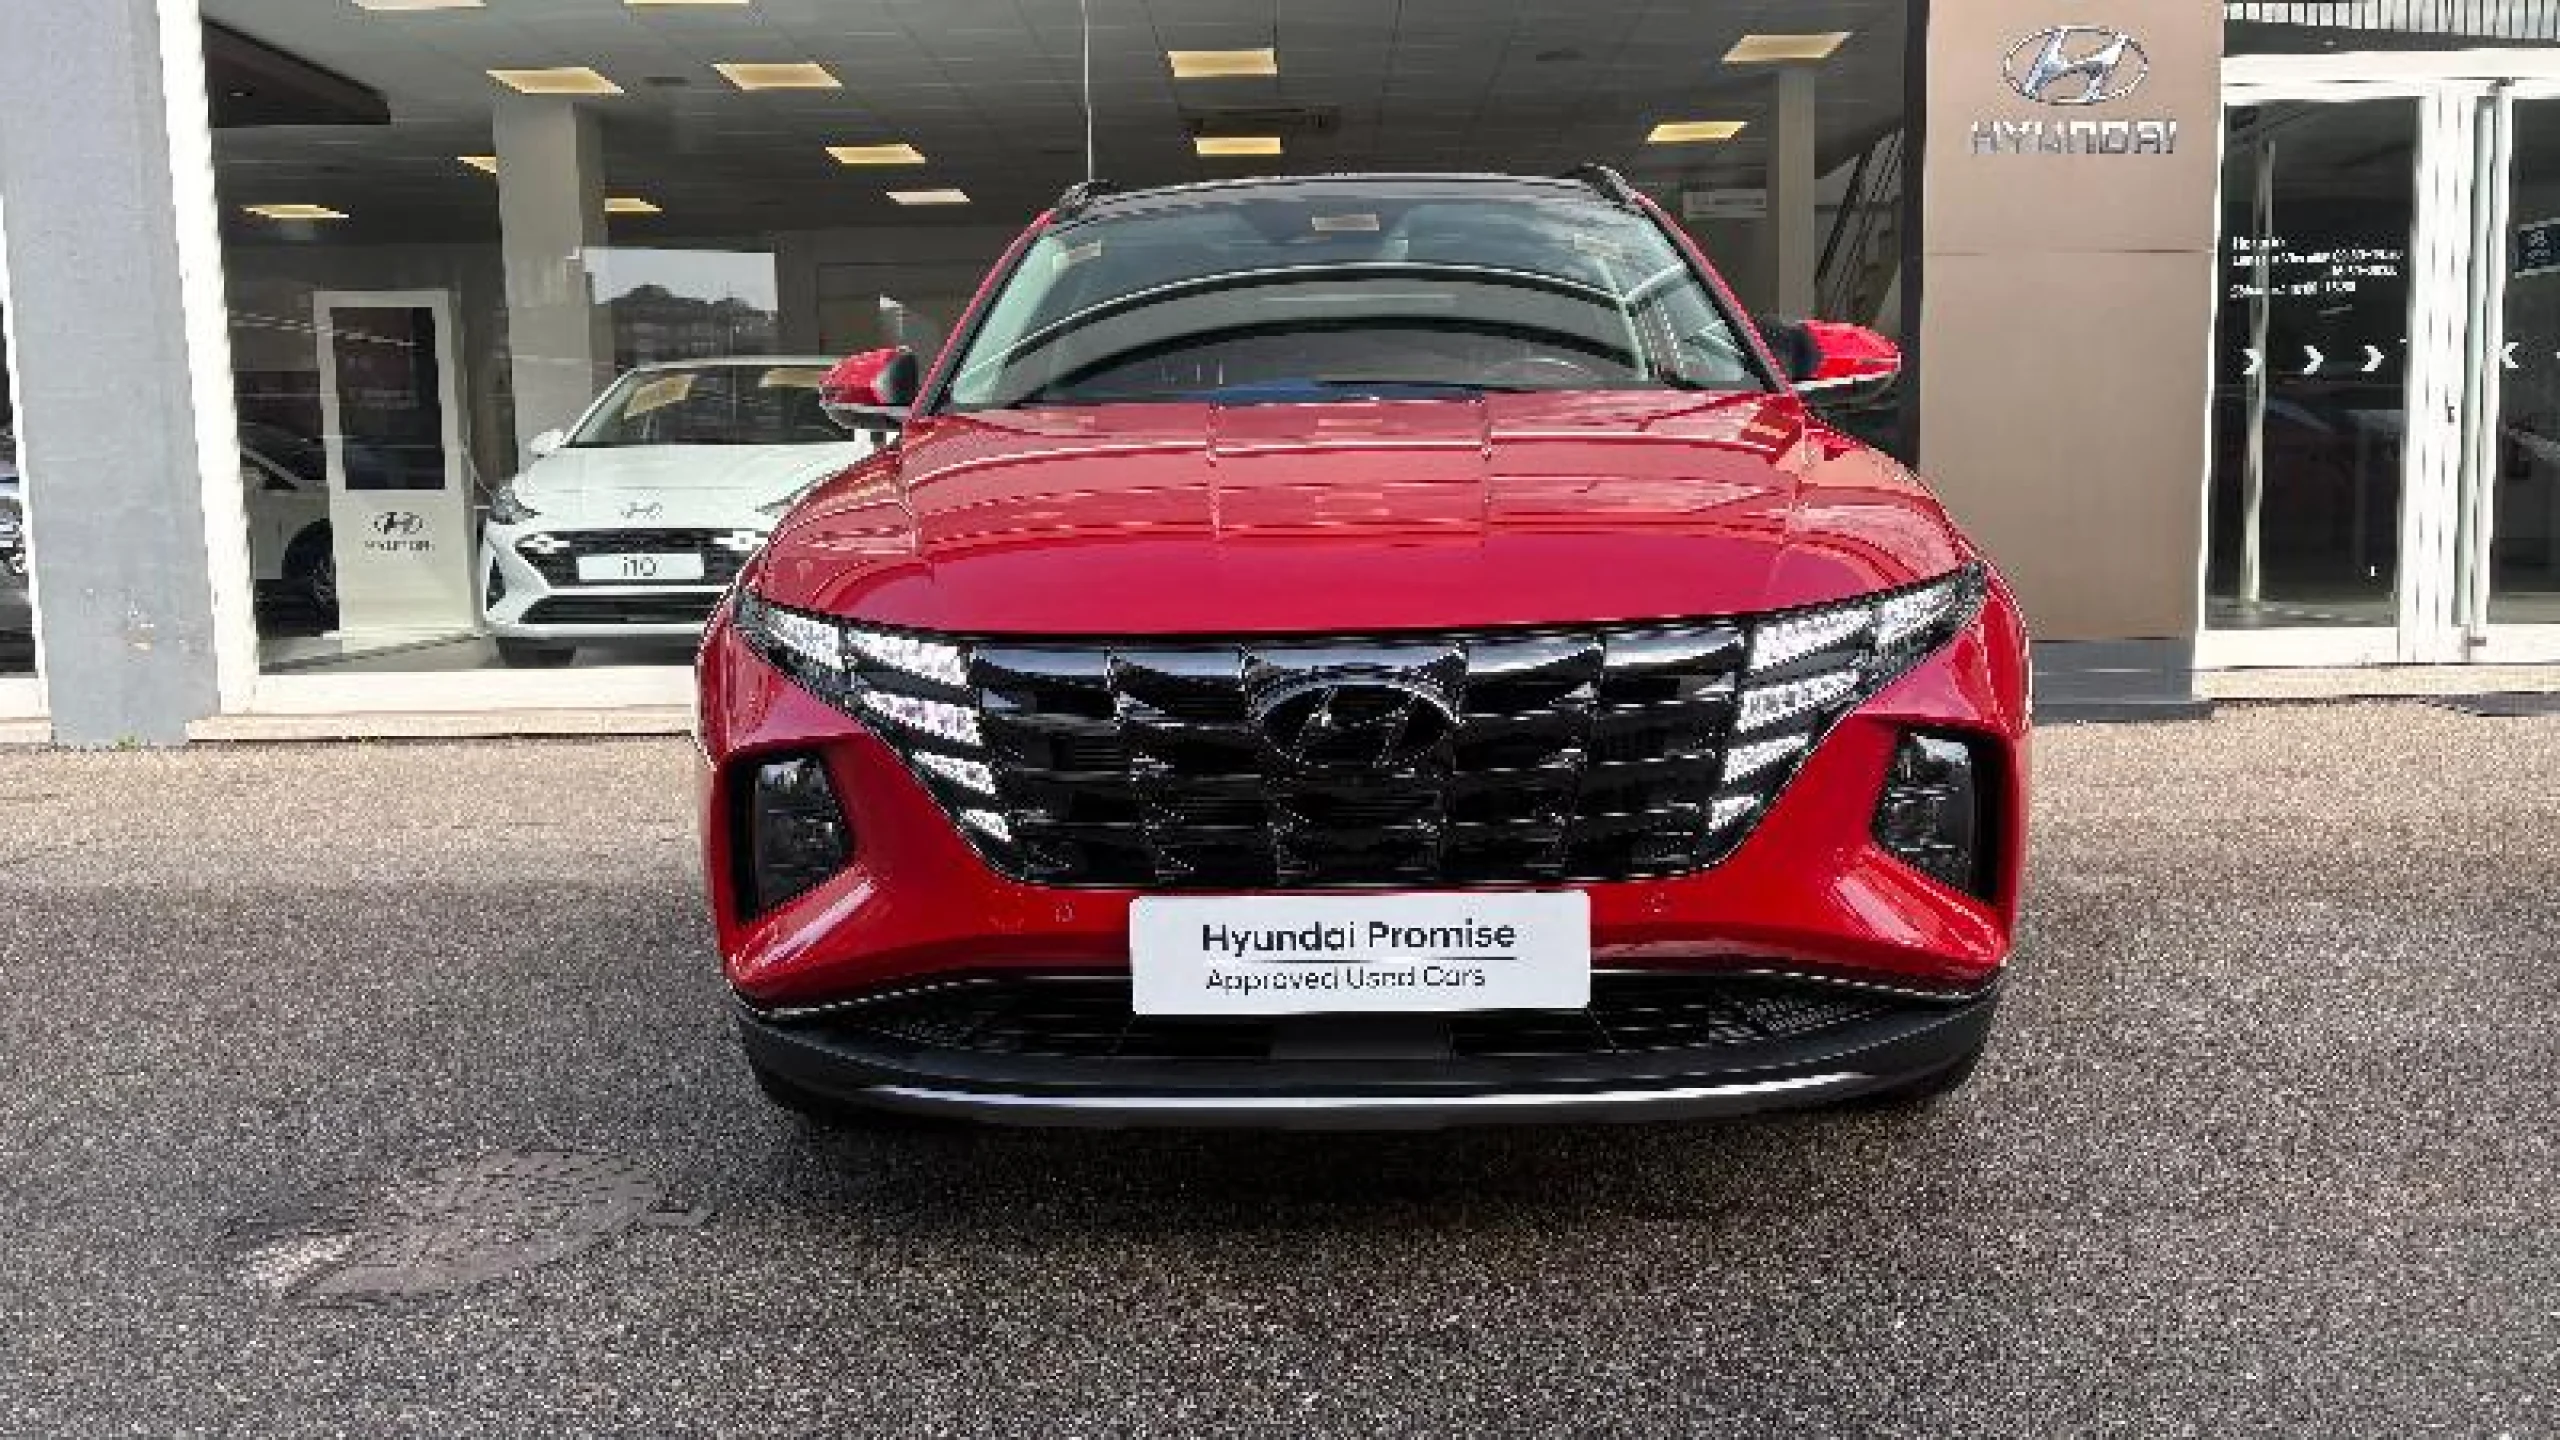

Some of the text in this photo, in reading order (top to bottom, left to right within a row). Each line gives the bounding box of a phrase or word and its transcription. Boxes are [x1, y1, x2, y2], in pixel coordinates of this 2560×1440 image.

[1970, 120, 2177, 154] HYUNDAI
[622, 555, 657, 577] i10
[1202, 918, 1516, 957] Hyundai Promise
[1206, 965, 1486, 995] Approved Used Cars
